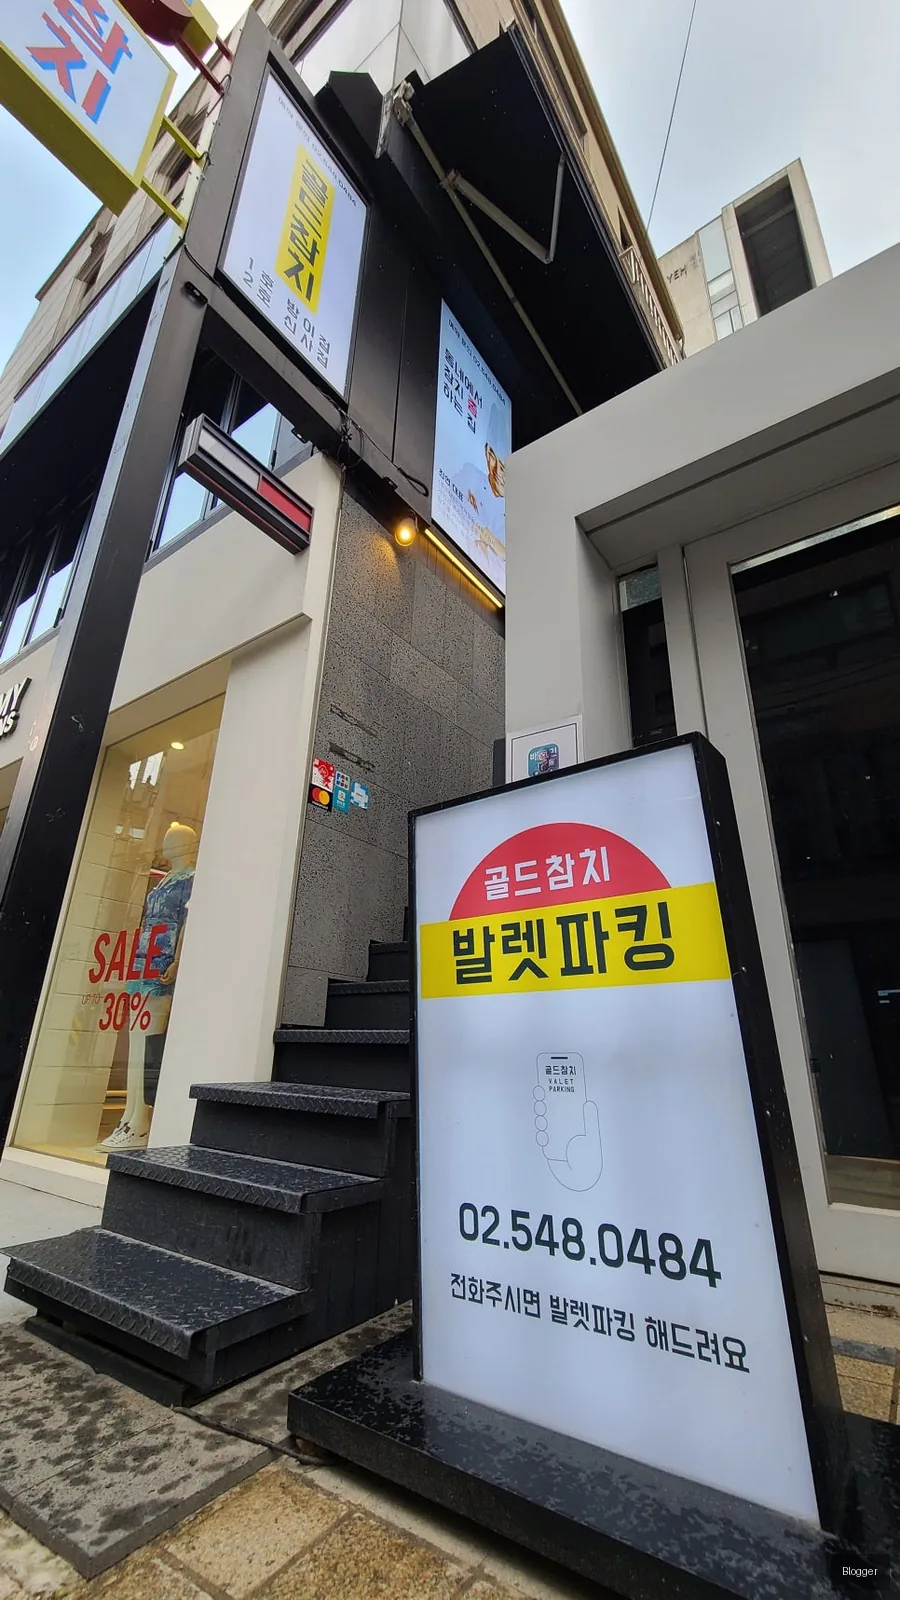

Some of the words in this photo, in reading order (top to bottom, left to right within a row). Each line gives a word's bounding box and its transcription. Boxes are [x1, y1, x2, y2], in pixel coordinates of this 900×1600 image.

[284, 159, 329, 303] 골드참치
[443, 382, 464, 417] 하는
[484, 846, 611, 901] 골드참치
[88, 923, 168, 984] SALE
[453, 901, 675, 985] 발렛파킹
[99, 990, 151, 1032] 30%
[545, 1065, 576, 1076] 골드참치
[458, 1202, 722, 1289] 02.548.0484
[450, 1272, 541, 1320] 전화주시면
[550, 1294, 636, 1342] 발렛파킹
[644, 1316, 750, 1374] 해드려요
